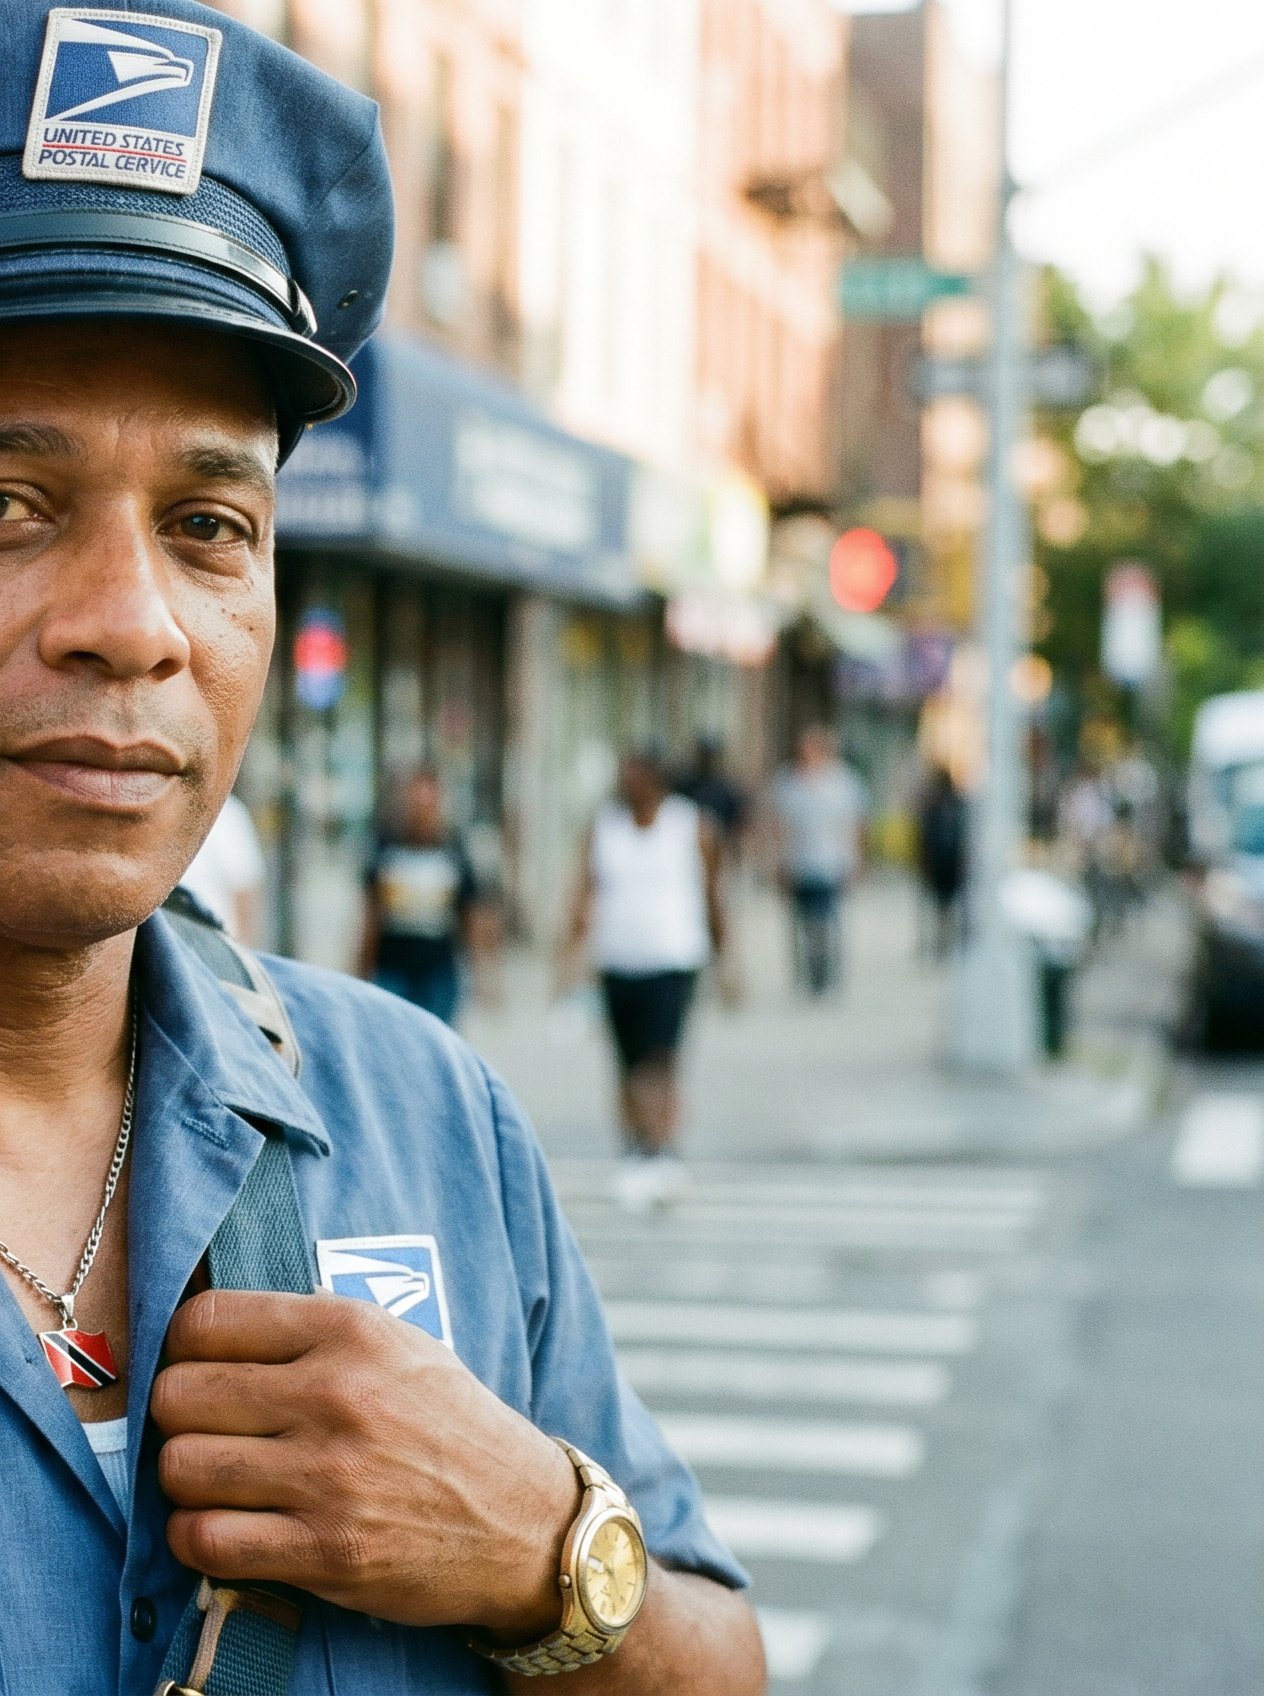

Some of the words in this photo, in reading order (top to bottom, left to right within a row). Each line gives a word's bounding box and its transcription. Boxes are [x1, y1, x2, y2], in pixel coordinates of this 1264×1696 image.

[43, 128, 116, 147] UNITED
[119, 134, 185, 156] STATES
[38, 149, 110, 169] POSTAL
